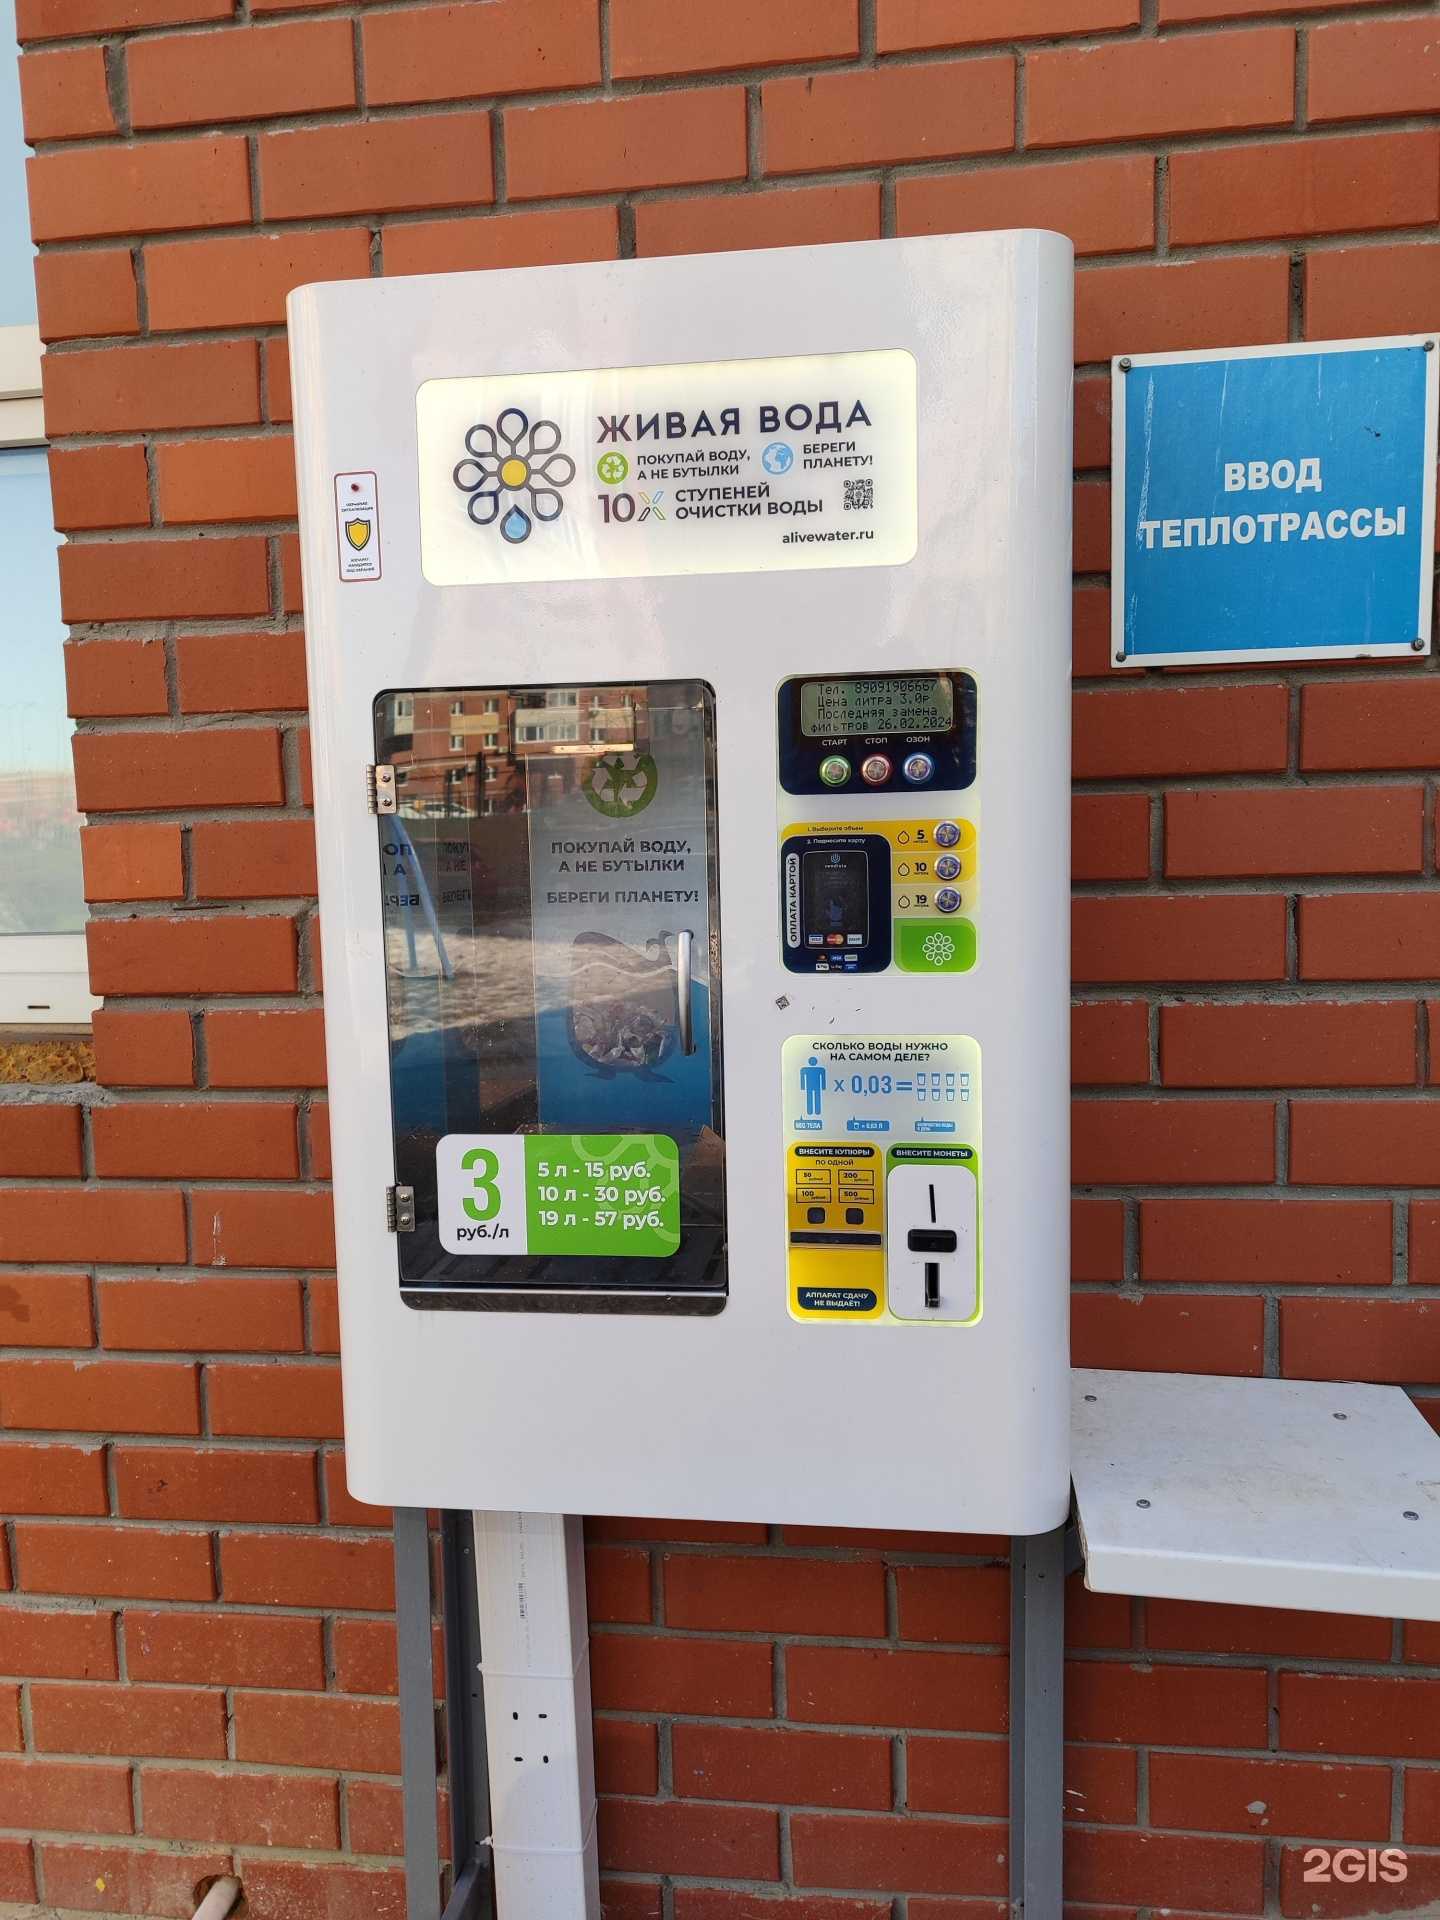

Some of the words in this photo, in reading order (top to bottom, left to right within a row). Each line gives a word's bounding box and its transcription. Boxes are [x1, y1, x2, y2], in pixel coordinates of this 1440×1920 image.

[596, 407, 741, 443] ЖИВАЯ
[759, 399, 872, 435] ВОДА
[803, 441, 856, 454] БЕРЕГИ
[637, 450, 705, 465] ПОКУПАЙ
[709, 449, 751, 462] ВОДУ,
[803, 455, 873, 470] ПЛАНЕТУ!
[637, 471, 647, 480] А
[650, 468, 669, 479] НЕ
[672, 464, 739, 478] БУТЫЛКИ
[1224, 457, 1322, 493] ВВОД
[675, 482, 770, 502] СТУПЕНЕЙ
[675, 501, 762, 520] ОЧИСТКИ
[767, 499, 823, 516] ВОДЫ
[1140, 506, 1406, 549] ТЕПЛОТРАССЫ
[782, 530, 874, 544] alivewater.ru
[817, 683, 845, 696] Тел.
[817, 696, 847, 708] Цена
[855, 696, 892, 707] литра
[817, 708, 885, 720] Последняя
[892, 707, 937, 717] замена
[810, 722, 869, 733] фильтров
[821, 738, 848, 747] СТАРТ
[865, 737, 888, 745] СТОП
[917, 829, 925, 840] 5
[551, 837, 635, 854] ПОКУПАЙ
[640, 840, 692, 854] ВОДУ,
[558, 861, 570, 872] А
[575, 860, 598, 872] НЕ
[602, 859, 685, 872] БУТЫЛКИ
[914, 862, 928, 872] 10
[788, 857, 797, 898] КАРТОЙ
[547, 891, 609, 904] БЕРЕГИ
[615, 890, 700, 903] ПЛАНЕТУ!
[915, 894, 928, 905] 19
[790, 900, 798, 942] ОПЛАТА
[812, 1041, 865, 1051] СКОЛЬКО
[868, 1041, 902, 1051] ВОДЫ
[905, 1042, 948, 1051] НУЖНО
[830, 1052, 846, 1061] НА
[848, 1052, 891, 1062] САМОМ
[894, 1053, 930, 1062] ДЕЛЕ?
[851, 1075, 892, 1097] 0,03
[538, 1162, 549, 1178] 5
[554, 1165, 567, 1178] л
[586, 1162, 604, 1178] 15
[609, 1162, 652, 1181] руб.
[461, 1148, 502, 1222] 3
[538, 1186, 558, 1202] 10
[563, 1189, 577, 1202] л
[595, 1186, 619, 1202] 30
[624, 1186, 666, 1205] руб.
[539, 1211, 559, 1227] 19
[563, 1213, 577, 1226] л
[595, 1211, 618, 1227] 57
[623, 1211, 664, 1230] руб.
[456, 1224, 509, 1241] руб./л
